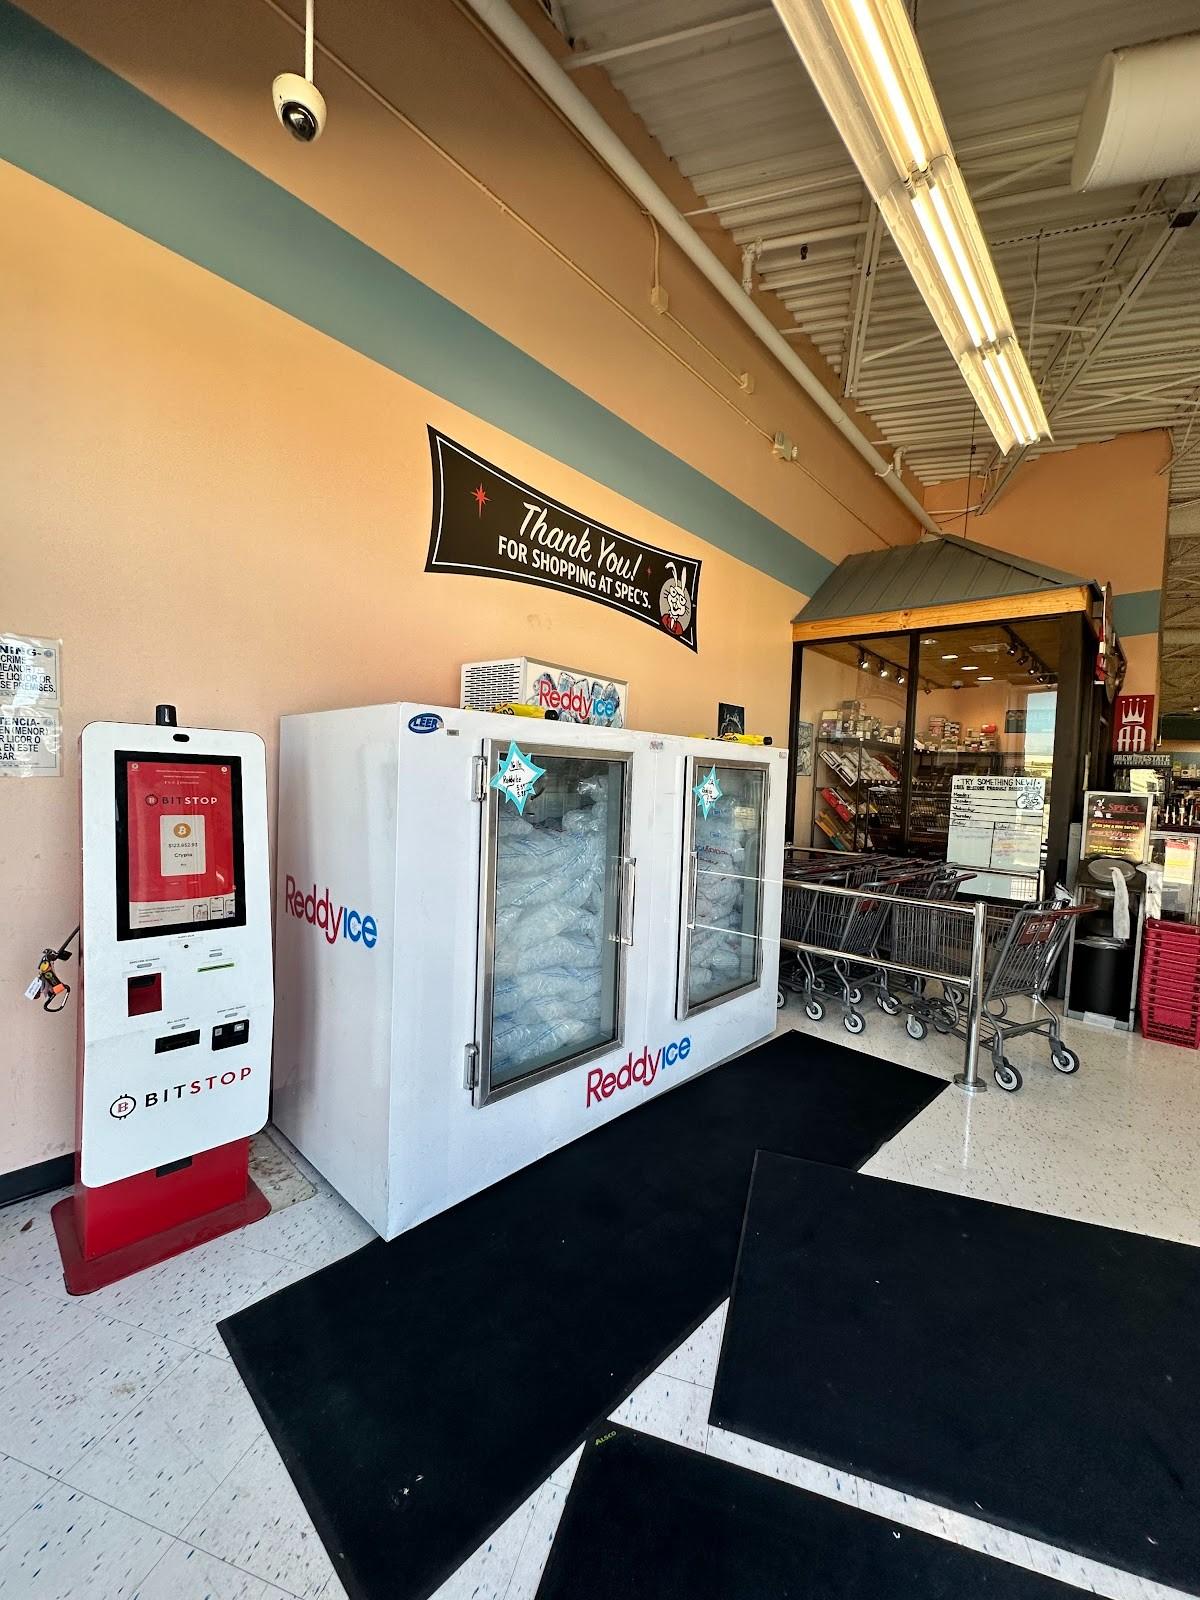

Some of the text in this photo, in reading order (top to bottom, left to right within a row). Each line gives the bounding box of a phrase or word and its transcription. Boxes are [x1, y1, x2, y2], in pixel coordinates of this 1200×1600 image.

[519, 501, 643, 582] Thank You!
[498, 535, 652, 609] FOR SHOPPING AT SPEC'S.
[17, 743, 39, 752] ESTE
[960, 778, 1037, 787] TRY SOMETHING NEW!
[162, 795, 218, 805] BITSTOP
[1108, 803, 1139, 812] SPEC'S
[145, 1067, 252, 1108] BITSTOP
